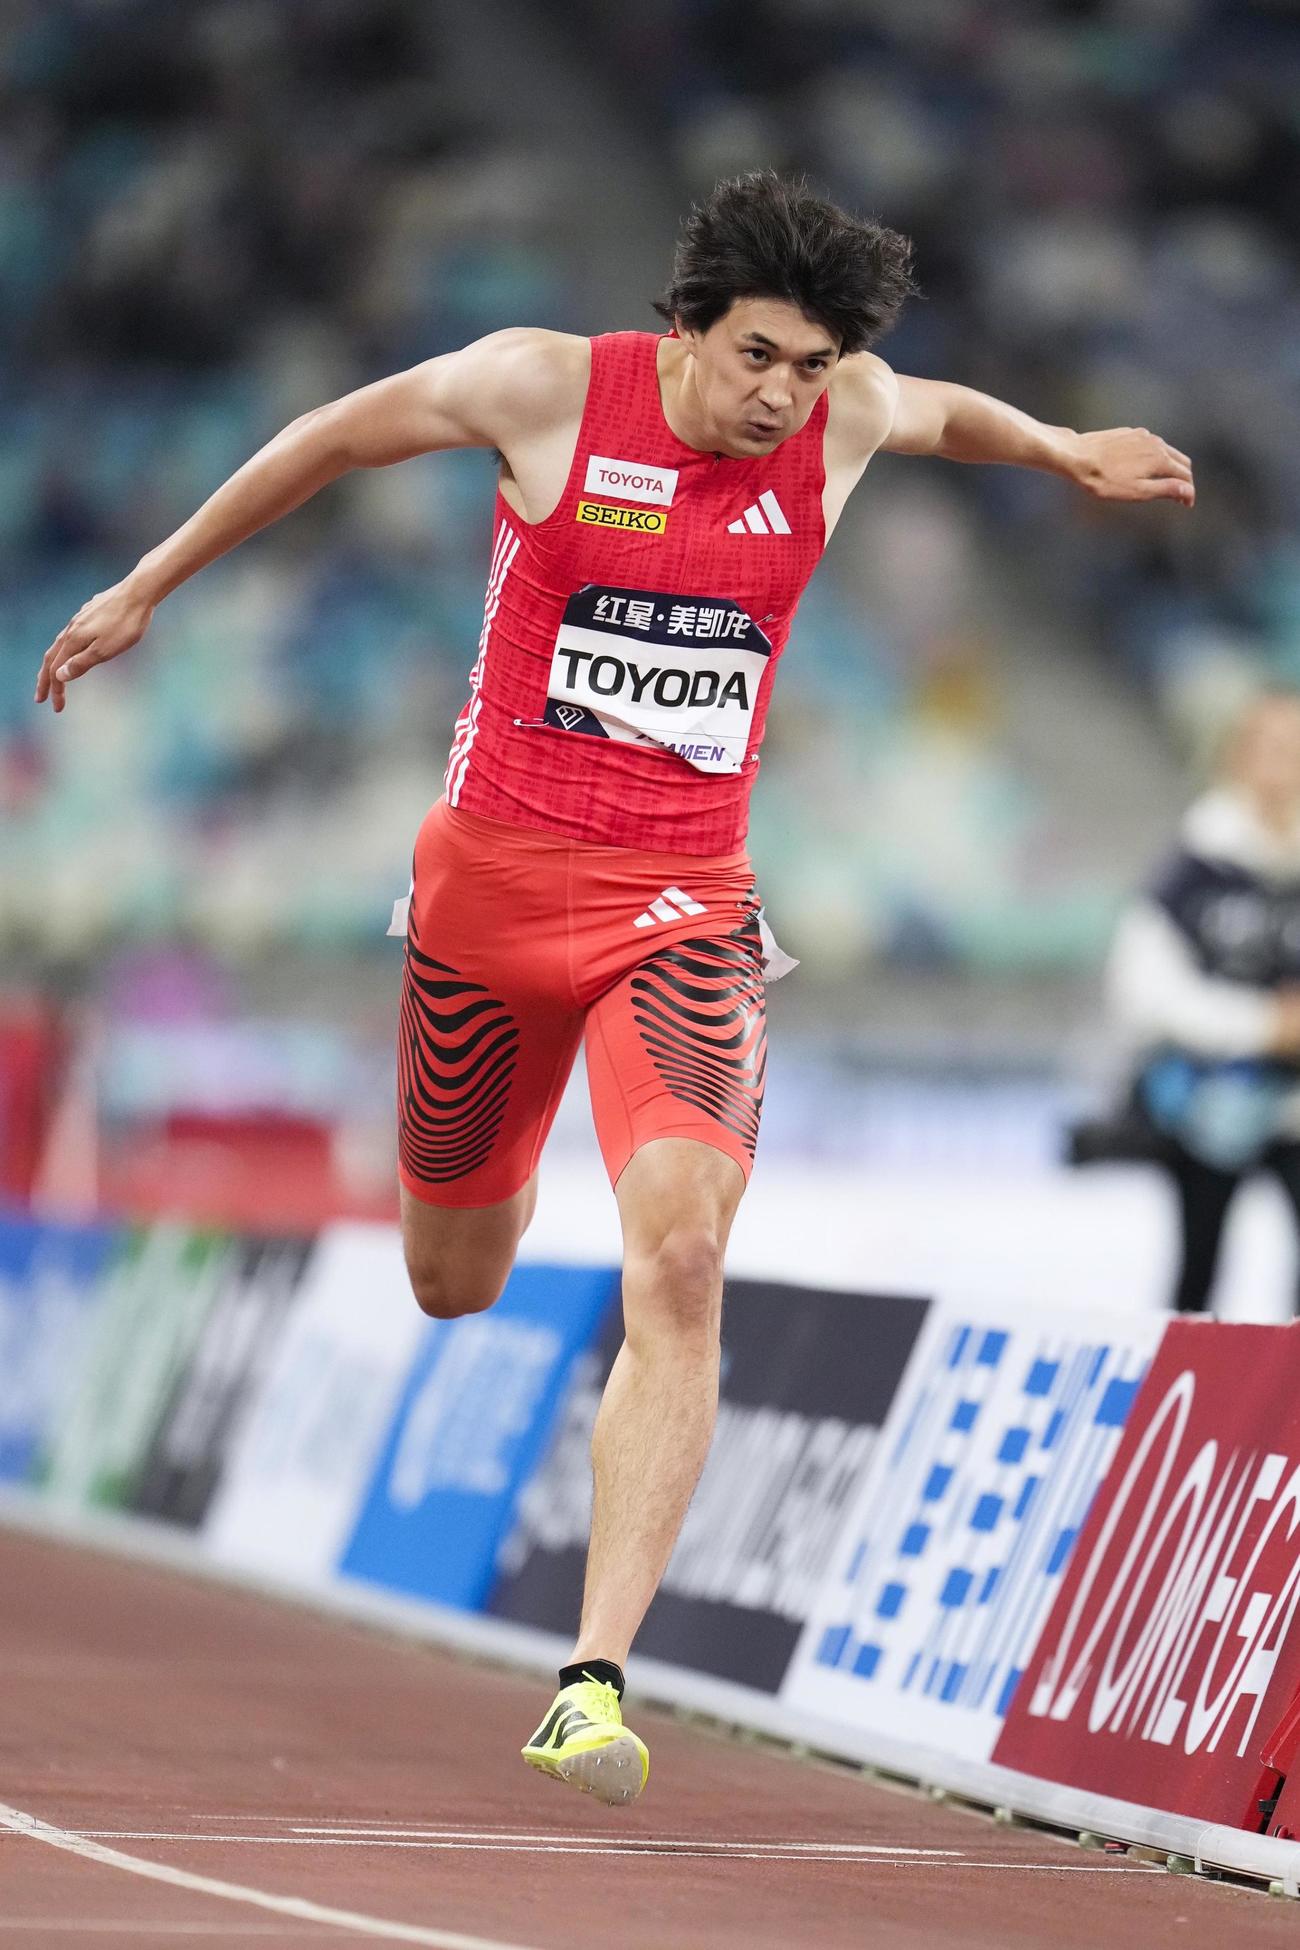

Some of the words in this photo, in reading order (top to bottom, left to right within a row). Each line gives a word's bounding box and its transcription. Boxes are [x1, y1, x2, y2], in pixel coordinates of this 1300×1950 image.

[599, 470, 664, 493] TOYOTA
[581, 504, 662, 531] SEIKO
[592, 595, 751, 639] 红星·美凯龙
[557, 648, 750, 711] TOYODA
